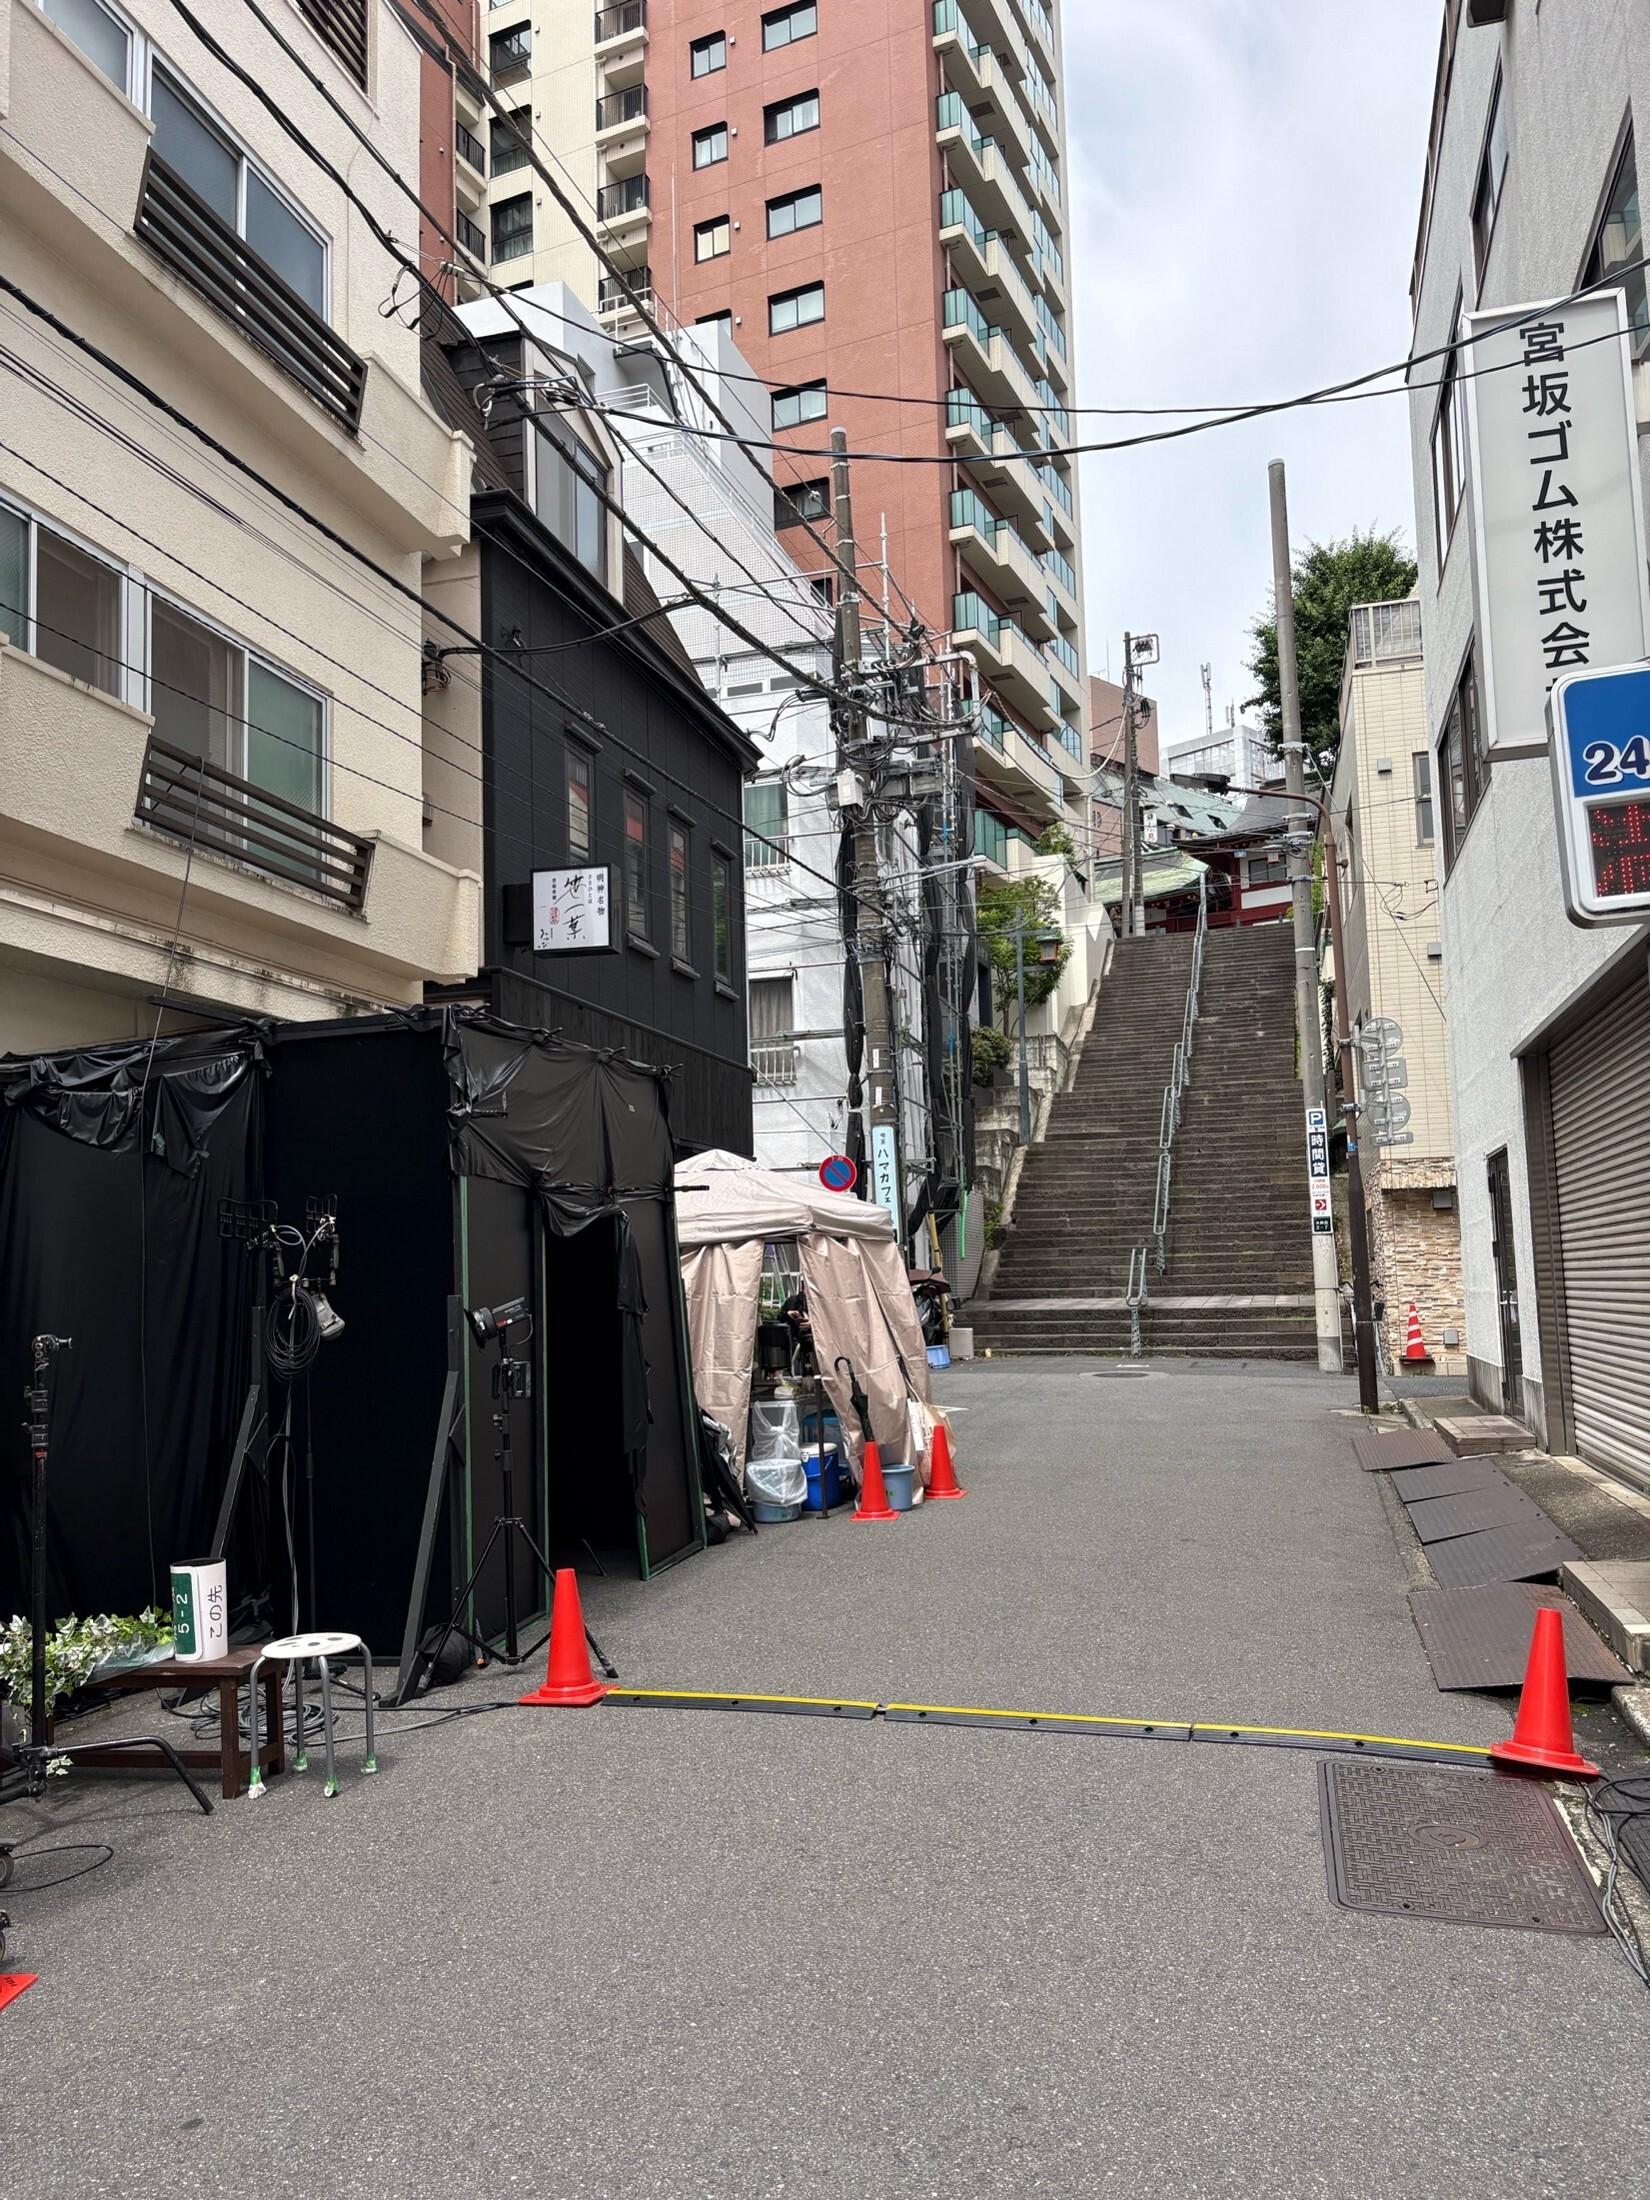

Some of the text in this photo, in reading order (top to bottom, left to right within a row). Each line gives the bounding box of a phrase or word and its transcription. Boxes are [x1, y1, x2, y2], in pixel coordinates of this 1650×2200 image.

[1519, 322, 1590, 692] 宮坂ゴム株式会
[1310, 1112, 1323, 1125] P
[877, 1148, 892, 1204] ハマカフェ
[1310, 1134, 1326, 1175] 時間貸
[207, 1584, 223, 1638] この先
